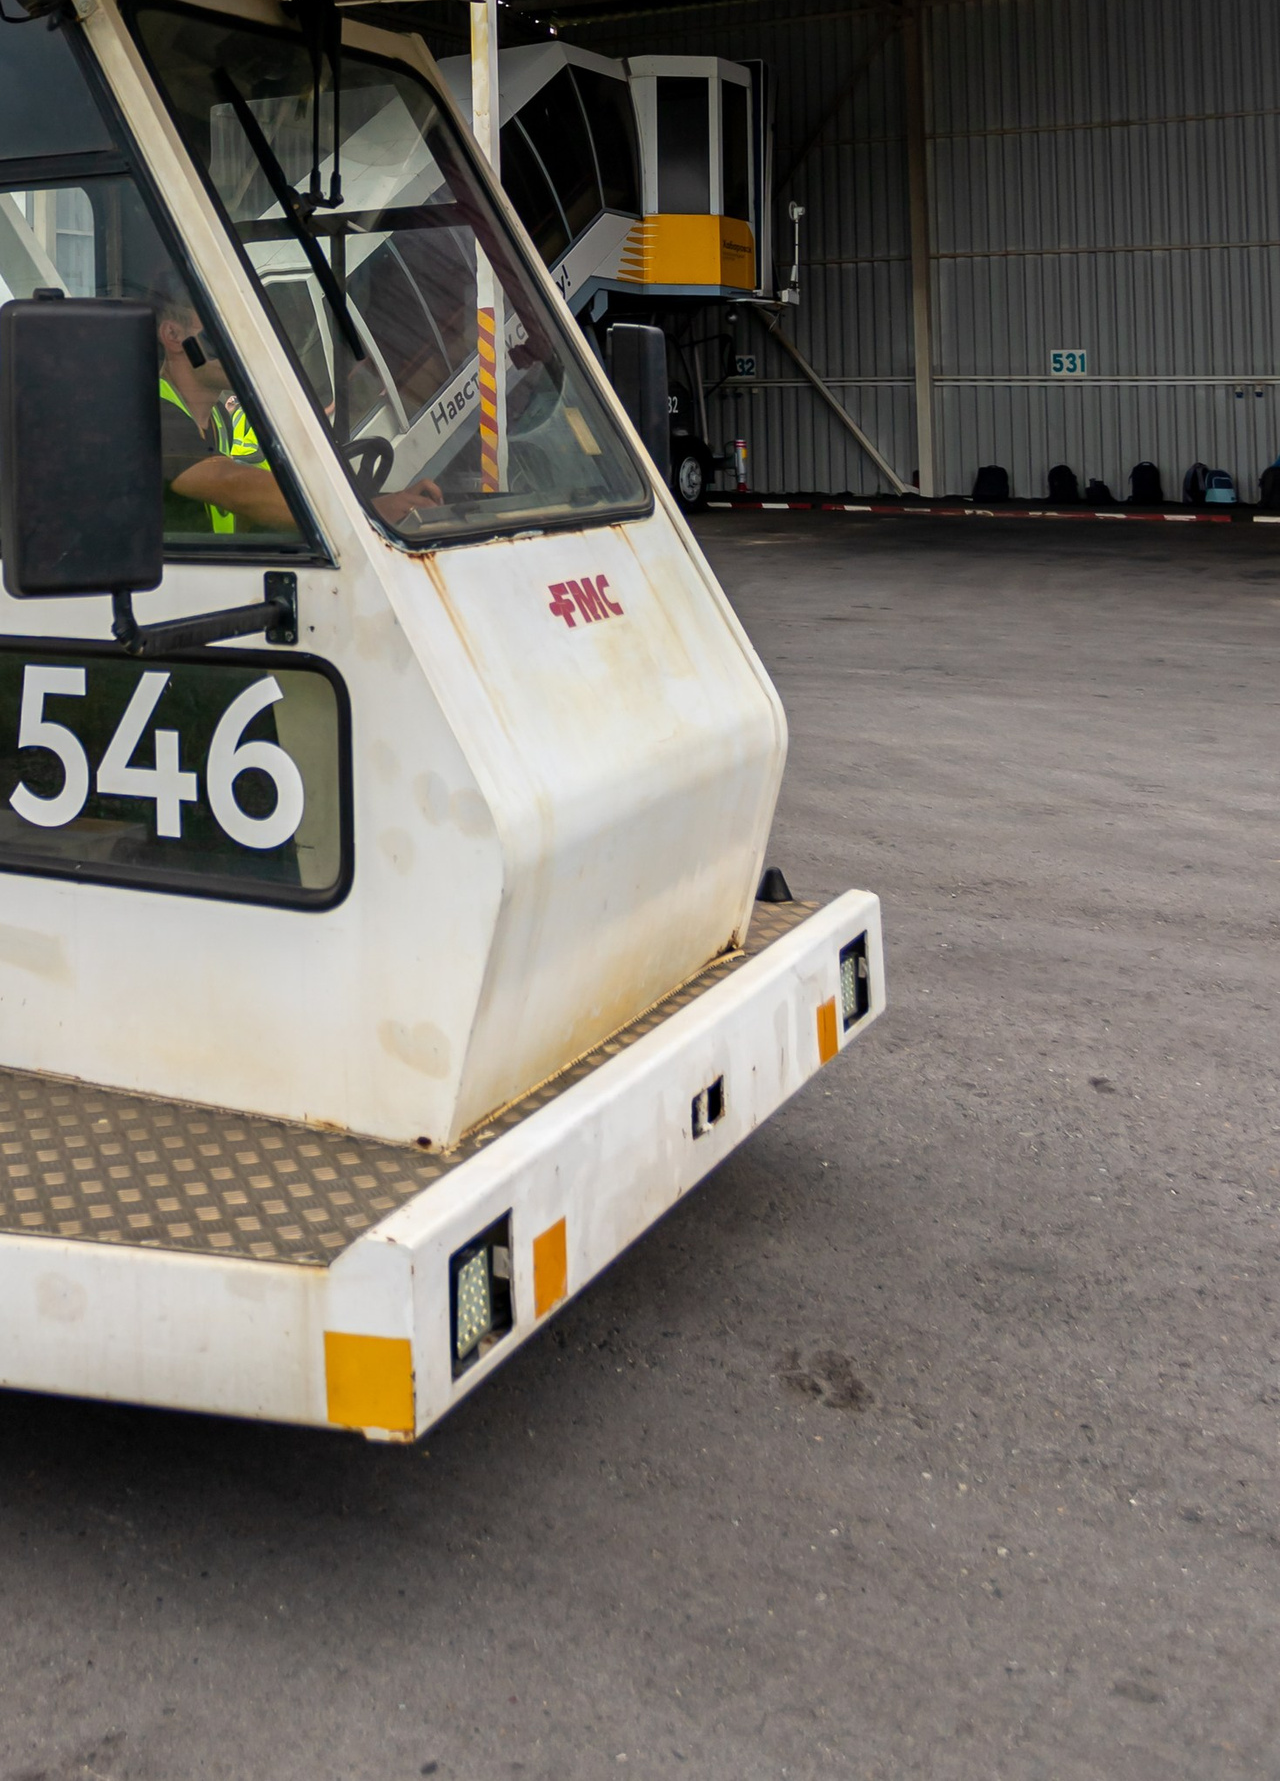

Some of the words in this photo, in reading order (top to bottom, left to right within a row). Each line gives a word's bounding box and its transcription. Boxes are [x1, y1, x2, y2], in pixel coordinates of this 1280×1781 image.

[1052, 352, 1085, 373] 531
[548, 574, 624, 628] FMC
[9, 664, 305, 849] 546
